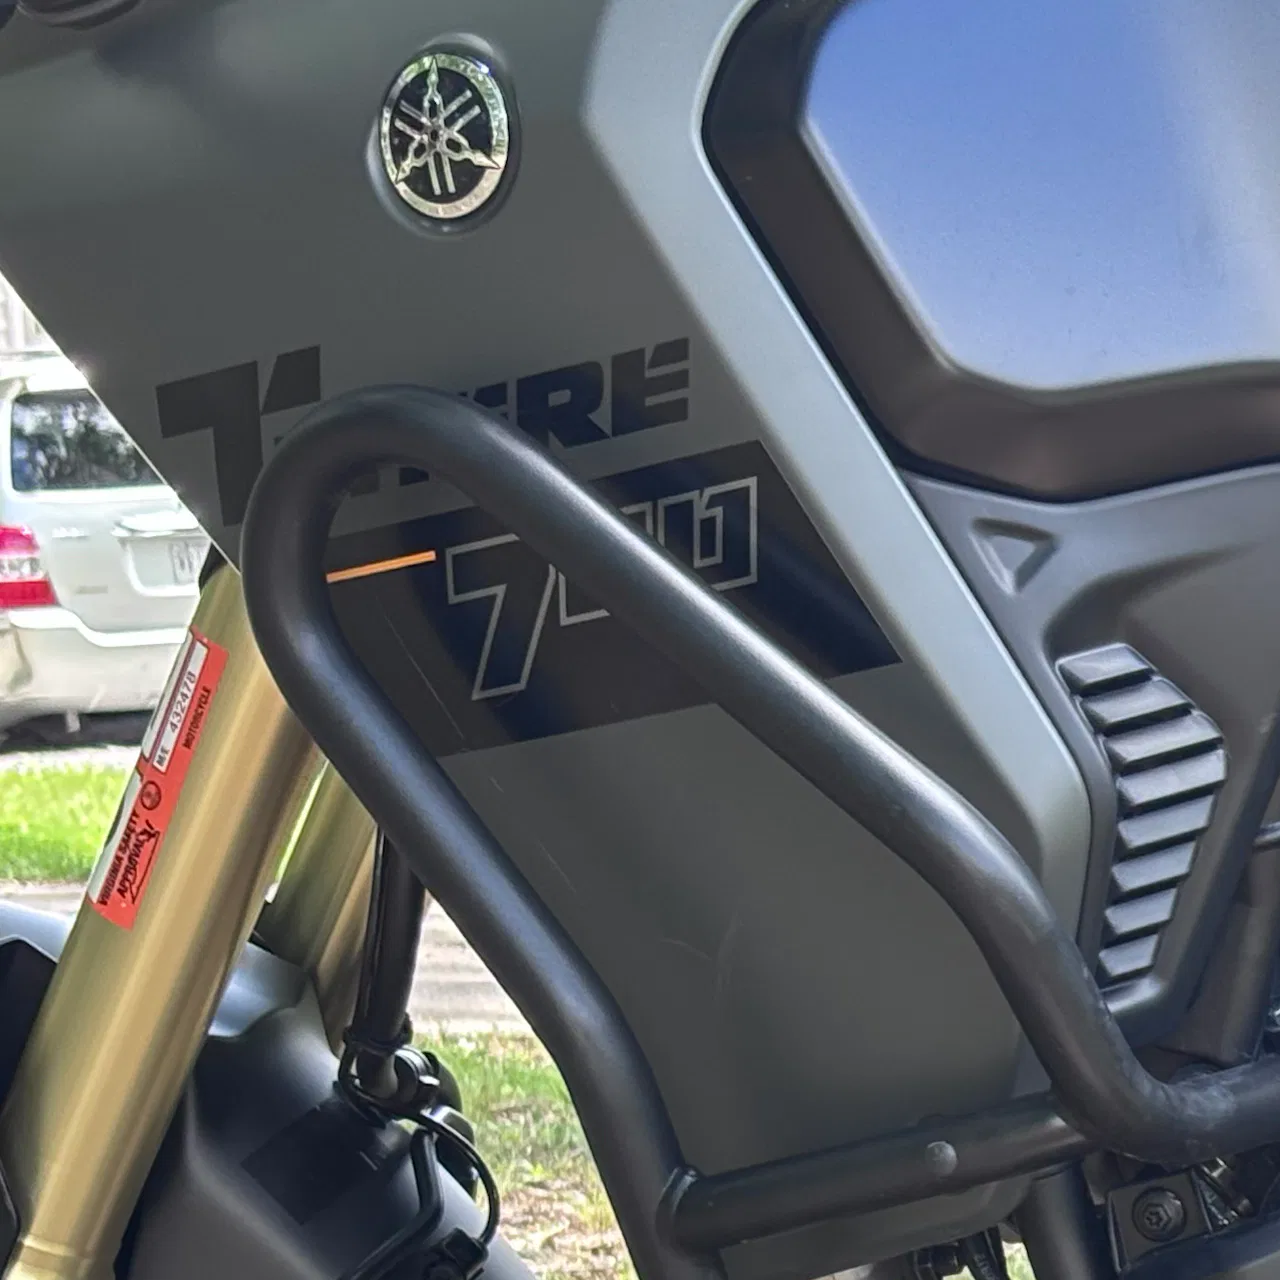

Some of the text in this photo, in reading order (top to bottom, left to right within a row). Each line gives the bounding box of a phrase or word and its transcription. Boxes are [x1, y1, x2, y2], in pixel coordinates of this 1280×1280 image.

[169, 671, 196, 733] 432478
[183, 686, 211, 748] MOTORCYCLE
[98, 855, 122, 905] VIRGINIA
